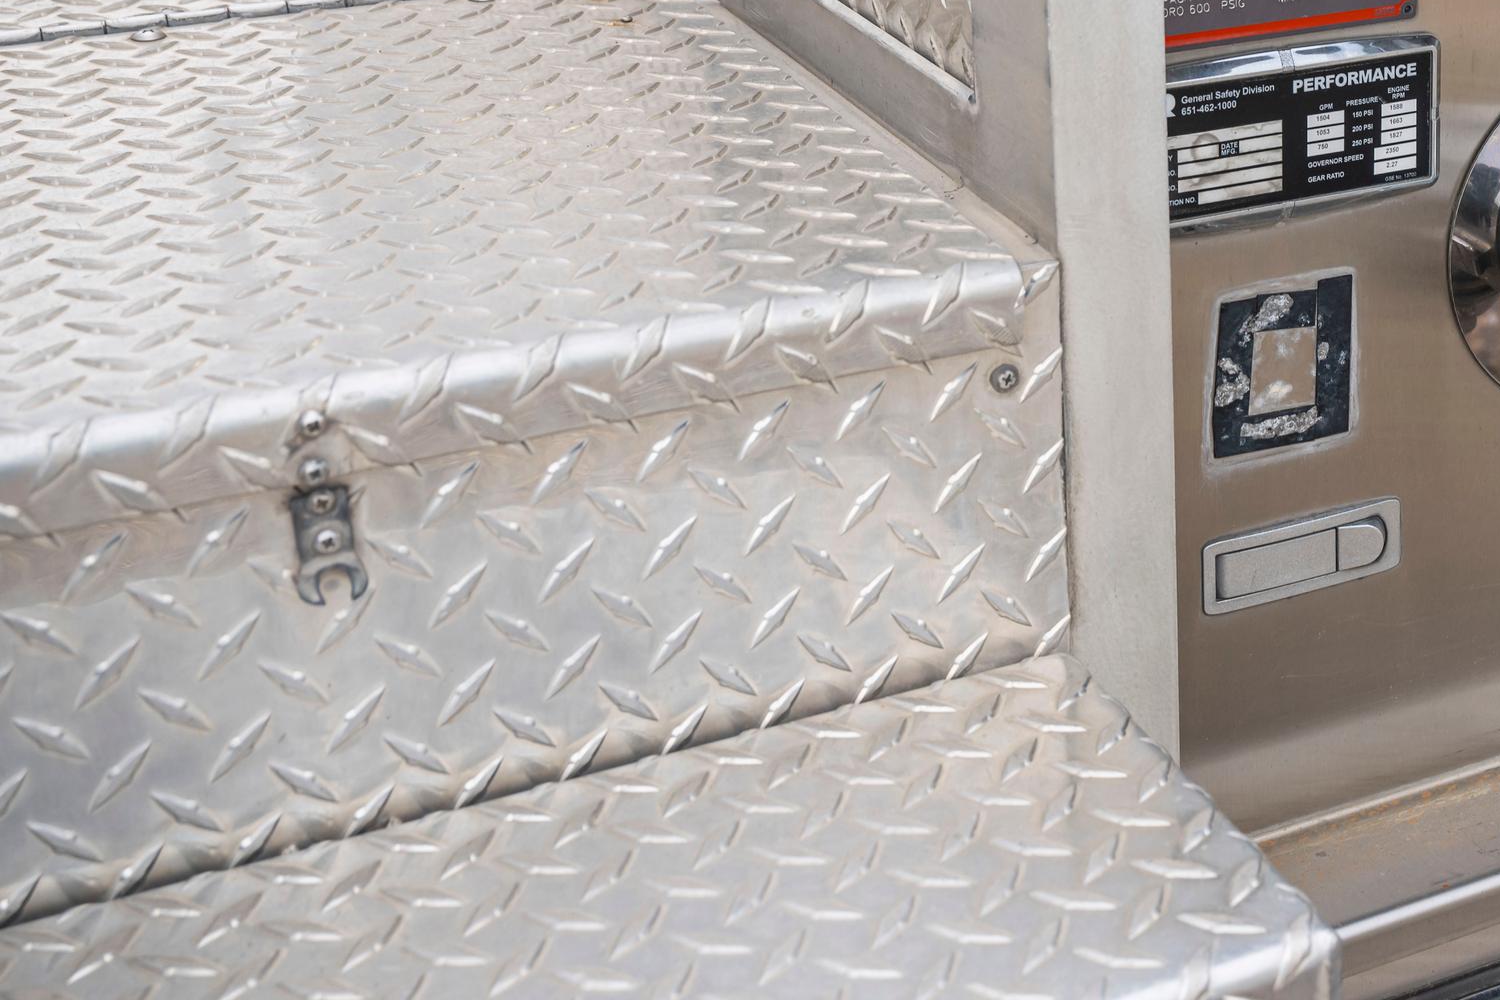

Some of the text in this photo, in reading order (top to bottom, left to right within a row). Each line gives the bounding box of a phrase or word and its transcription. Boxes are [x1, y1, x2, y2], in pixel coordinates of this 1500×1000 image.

[1189, 2, 1211, 15] 600
[1292, 62, 1417, 94] PERFORMANCE
[1181, 84, 1275, 104] General Safety Division
[1387, 84, 1410, 94] ENGINE
[1392, 92, 1405, 100] RPM
[1345, 96, 1379, 107] PRESSURE
[1181, 100, 1237, 116] 651-462-1000
[1319, 103, 1333, 111] GPM
[1364, 109, 1374, 117] PSI
[1352, 125, 1362, 133] 200
[1220, 141, 1239, 150] DATE
[1352, 138, 1374, 147] 250 PSI
[1220, 147, 1238, 156] MFG.
[1307, 154, 1364, 168] GOVERNOR SPEED
[1307, 171, 1345, 183] GEAR RATIO
